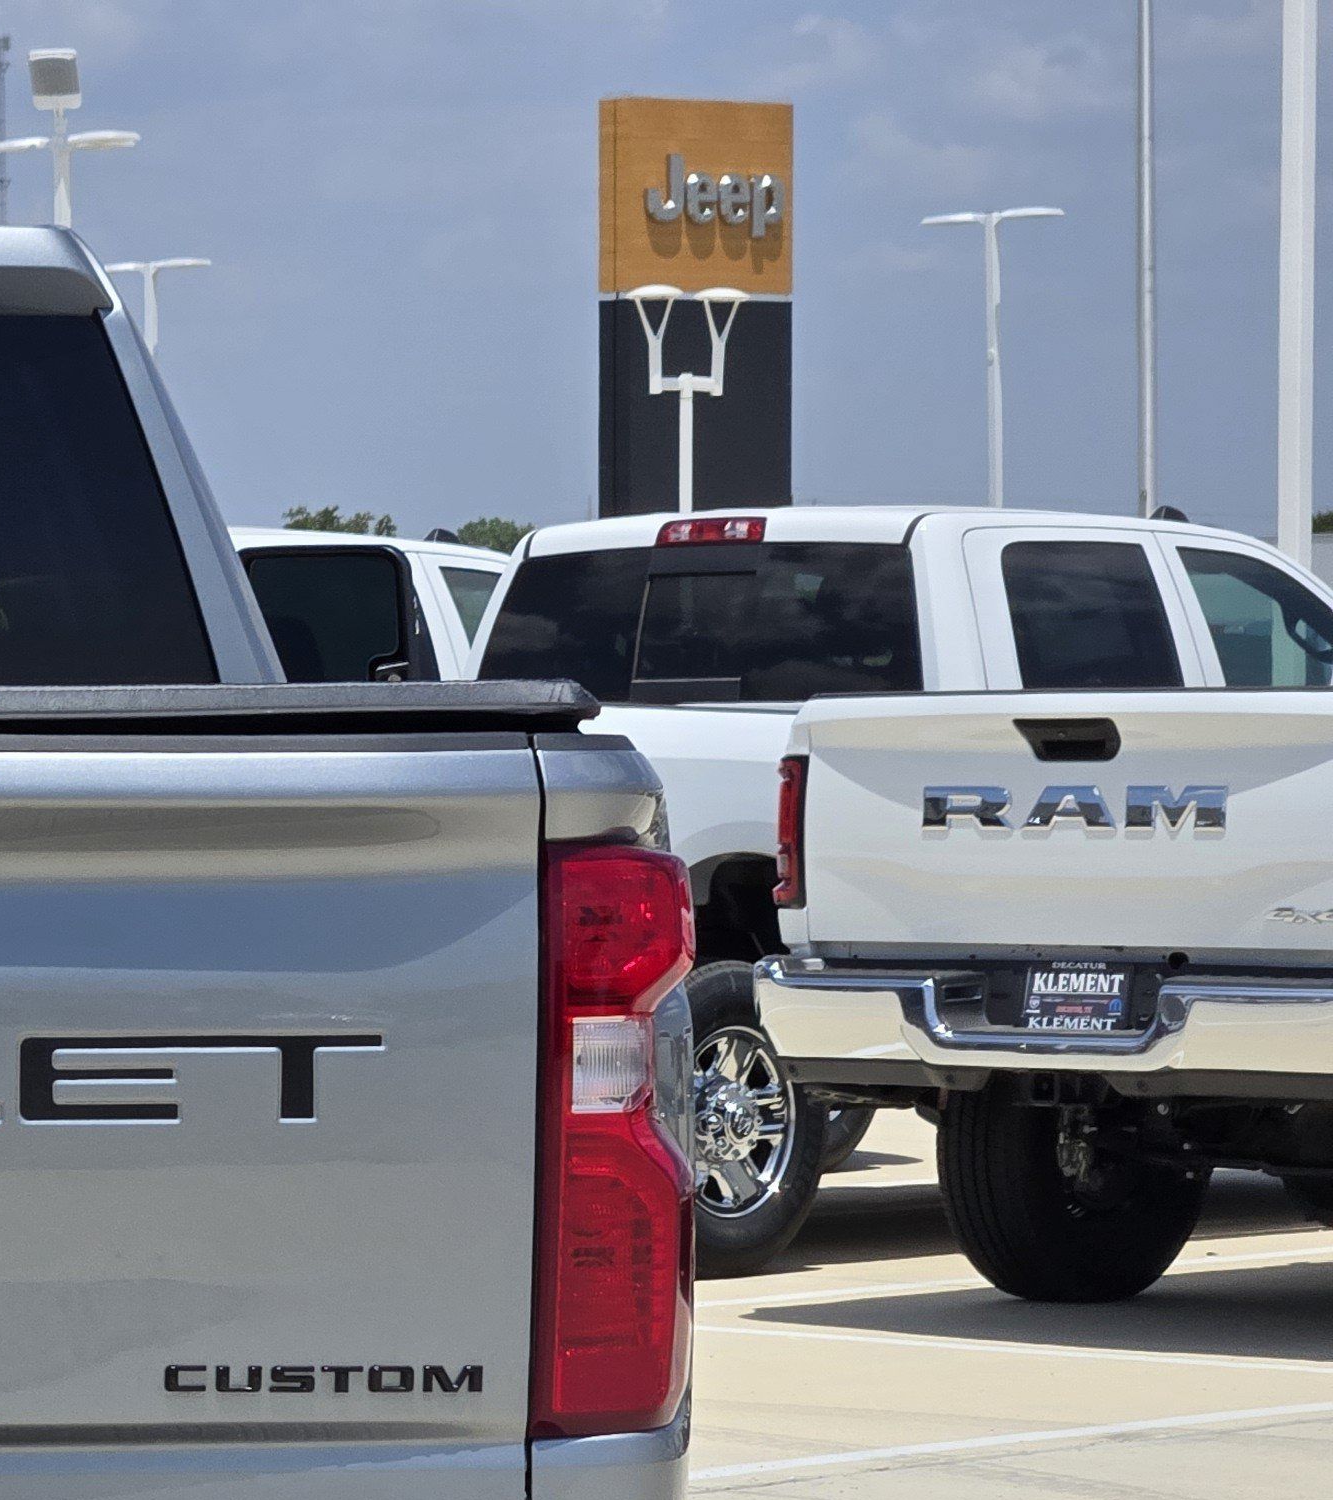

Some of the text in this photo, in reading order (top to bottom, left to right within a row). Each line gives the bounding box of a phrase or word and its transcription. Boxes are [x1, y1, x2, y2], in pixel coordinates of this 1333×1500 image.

[645, 153, 783, 238] Jeep
[923, 785, 1228, 832] RAM
[1051, 962, 1107, 970] DECATUR
[1033, 972, 1125, 993] KLEMENT
[1028, 1016, 1116, 1031] KLEMENT
[164, 1363, 483, 1394] CUSTOM
